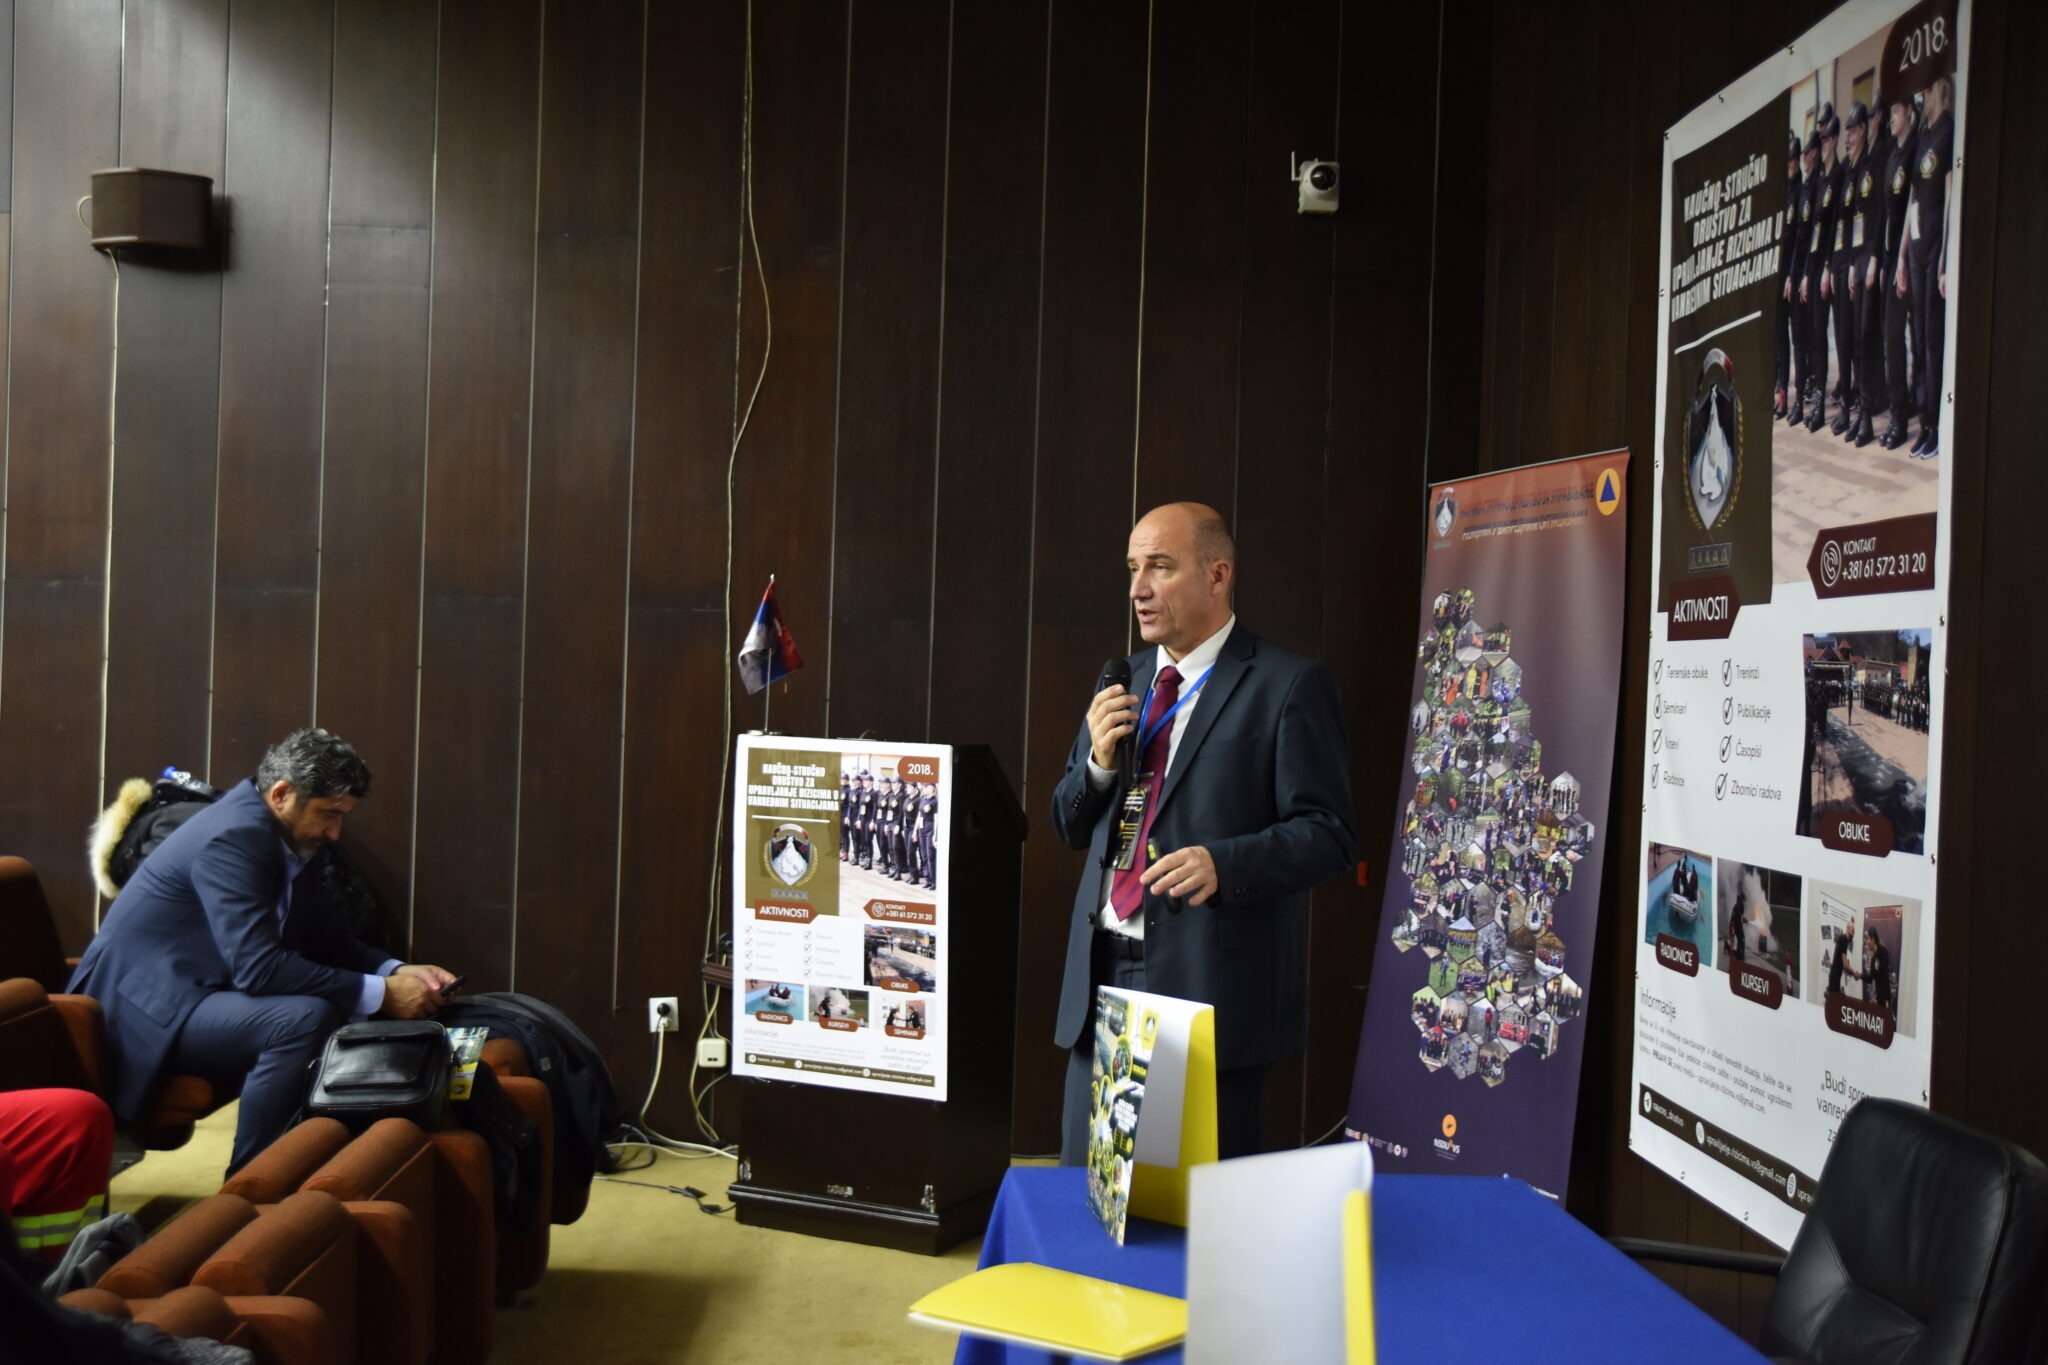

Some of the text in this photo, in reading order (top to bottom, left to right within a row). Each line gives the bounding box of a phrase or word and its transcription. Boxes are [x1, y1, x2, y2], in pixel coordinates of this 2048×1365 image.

[1899, 16, 1948, 72] 2018.
[1738, 195, 1752, 226] ZA
[1726, 216, 1772, 263] RIZICIMA
[1775, 211, 1783, 240] U
[1712, 245, 1780, 300] SITUACIJAMA
[1843, 537, 1877, 555] KONTAKT
[1842, 552, 1926, 579] +381 61 572 31 20
[1673, 595, 1728, 622] AKTIVNOSTI
[1667, 665, 1690, 679] Terenske
[1736, 664, 1759, 679] Treninzi
[1738, 703, 1771, 722] Publikacije
[907, 763, 934, 776] 2018.
[805, 777, 815, 787] ZA
[833, 789, 839, 800] U
[1838, 821, 1870, 842] OBUKE
[760, 905, 809, 918] AKTIVNOSTI
[1660, 942, 1693, 966] RADIONICE
[1741, 972, 1769, 995] KURSEVI
[1841, 1005, 1884, 1036] SEMINARI
[1848, 1086, 1868, 1104] spre
[1817, 1097, 1847, 1121] vanred
